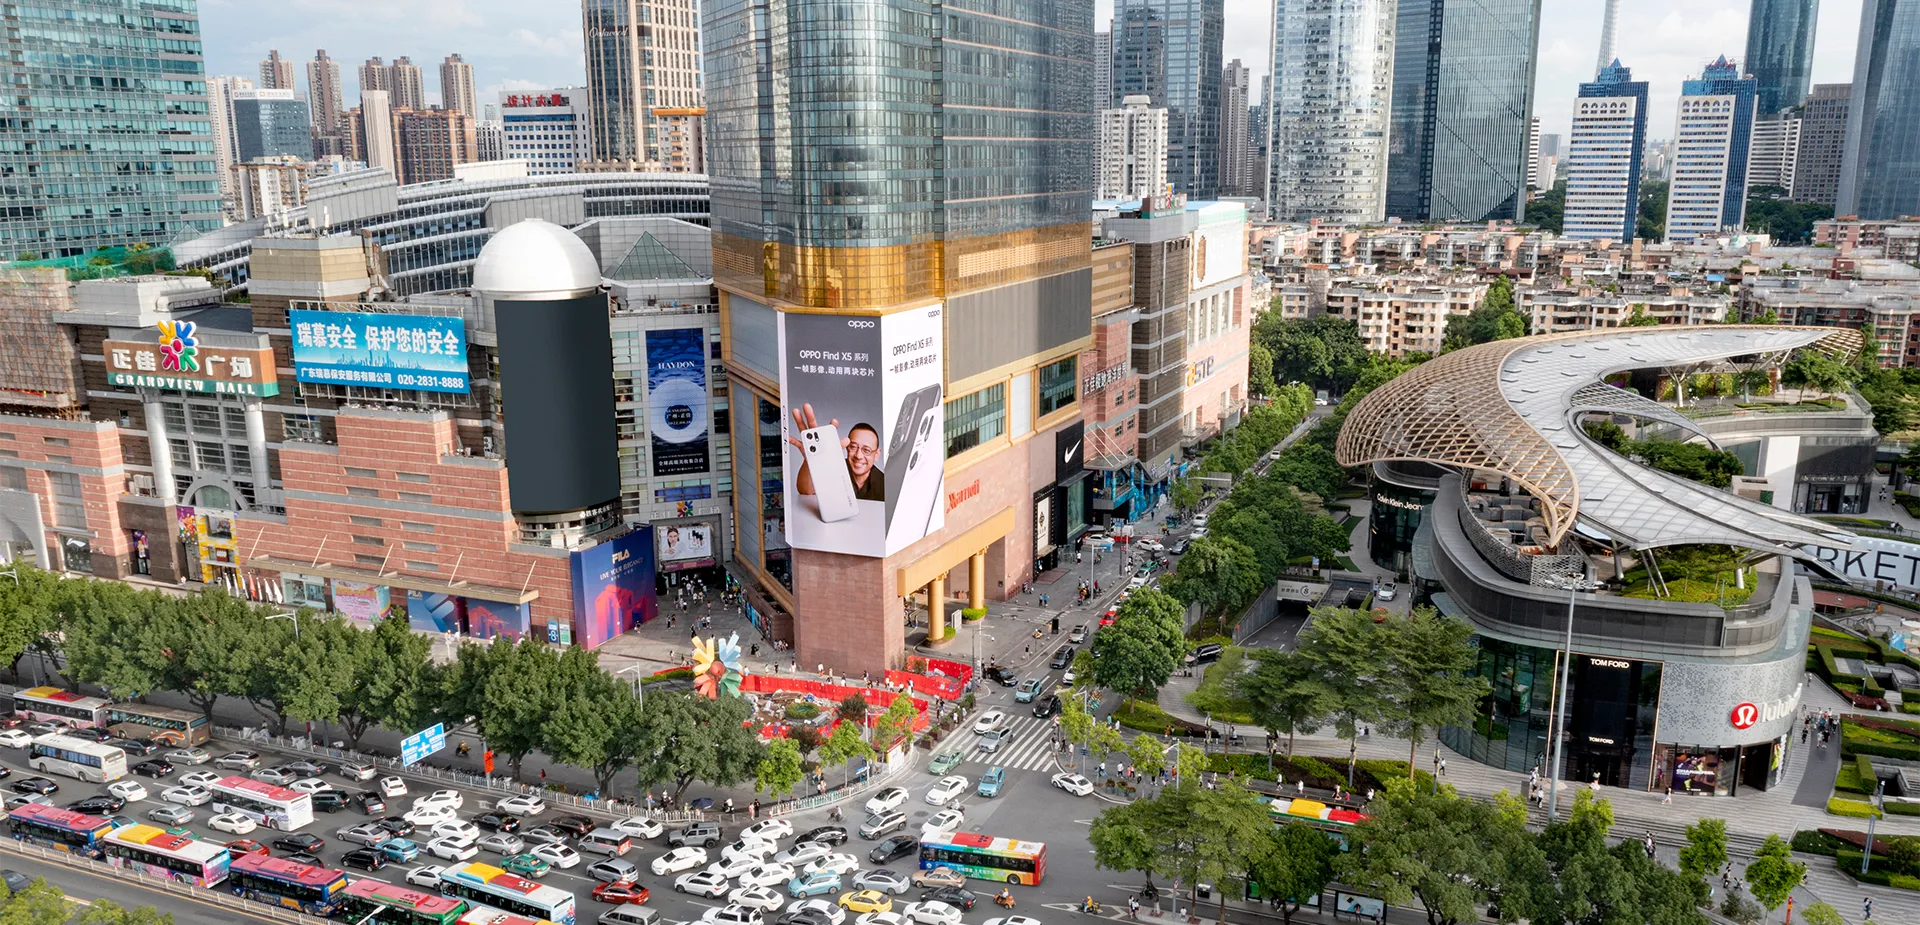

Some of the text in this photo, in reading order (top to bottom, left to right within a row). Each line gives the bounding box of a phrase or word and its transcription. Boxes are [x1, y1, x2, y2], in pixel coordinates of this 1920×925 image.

[928, 310, 940, 318] oppo
[848, 320, 875, 329] oppo
[297, 322, 459, 355] 瑞慕安全 保护您的安全
[893, 344, 906, 356] OPPO
[907, 341, 917, 352] Find
[918, 339, 925, 349] X5
[799, 349, 869, 362] OPPO Find X5 系列
[112, 349, 253, 378] 正佳 广场
[658, 361, 695, 369] HAYDON
[115, 374, 256, 395] GRANDVIEW MALL
[301, 367, 464, 389] 广东瑞慕保安服务有限公司 020-2831-8888
[1389, 498, 1404, 508] Klein
[611, 548, 630, 564] FILA
[408, 589, 423, 598] FILA
[1590, 658, 1630, 669] TOM FORD
